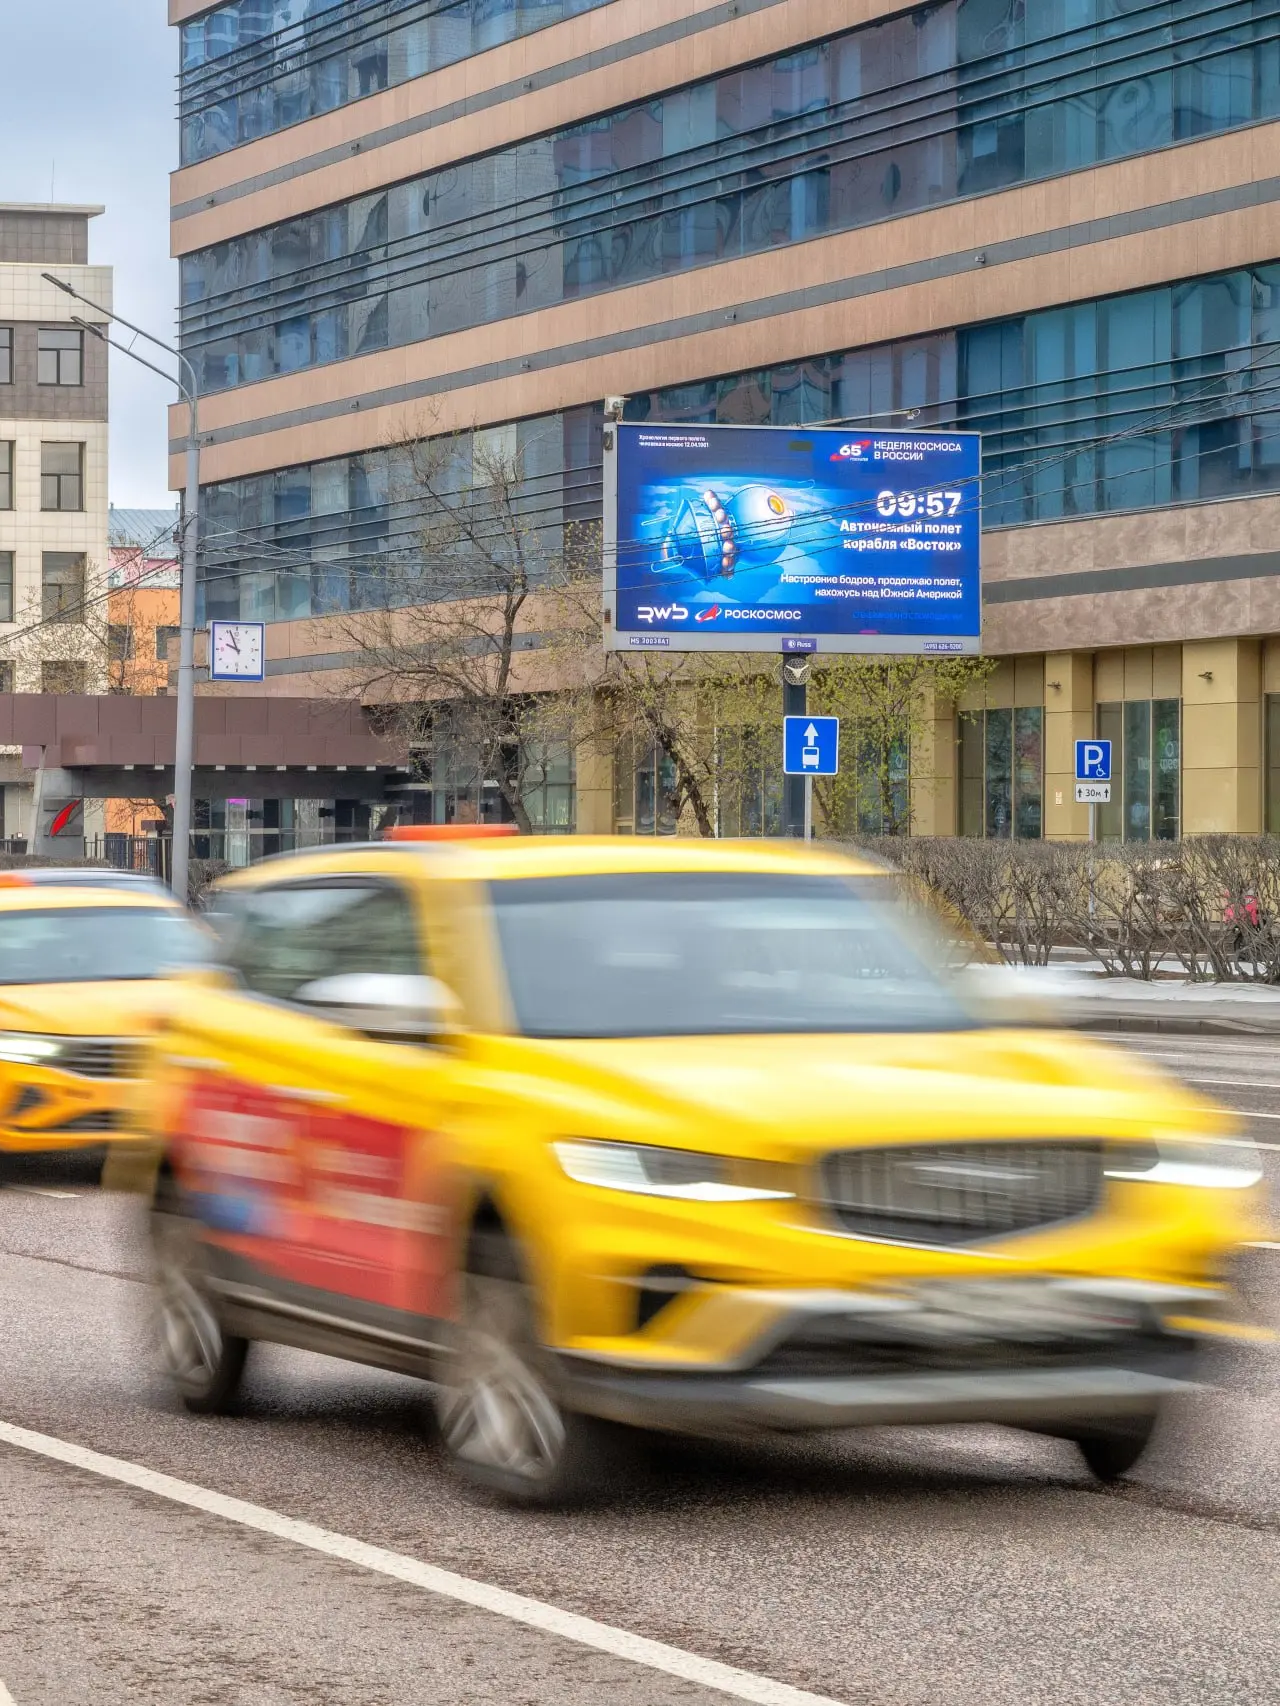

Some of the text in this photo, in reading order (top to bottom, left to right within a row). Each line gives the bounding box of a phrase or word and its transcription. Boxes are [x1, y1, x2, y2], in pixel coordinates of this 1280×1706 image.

[839, 444, 862, 456] 65
[873, 440, 962, 452] НЕДЕЛЯ КОСМОСА
[873, 451, 881, 460] В
[882, 452, 923, 461] РОССИИ
[876, 490, 962, 517] 09:57
[924, 523, 962, 534] полет
[843, 538, 962, 552] корабля «Восток»
[780, 574, 963, 588] Настроение бодрое, продолжаю полет,
[814, 588, 962, 599] нахожусь над Южной Америкой
[724, 609, 802, 620] РОСКОСМОС
[1084, 744, 1104, 775] P
[1085, 788, 1102, 797] 30м
